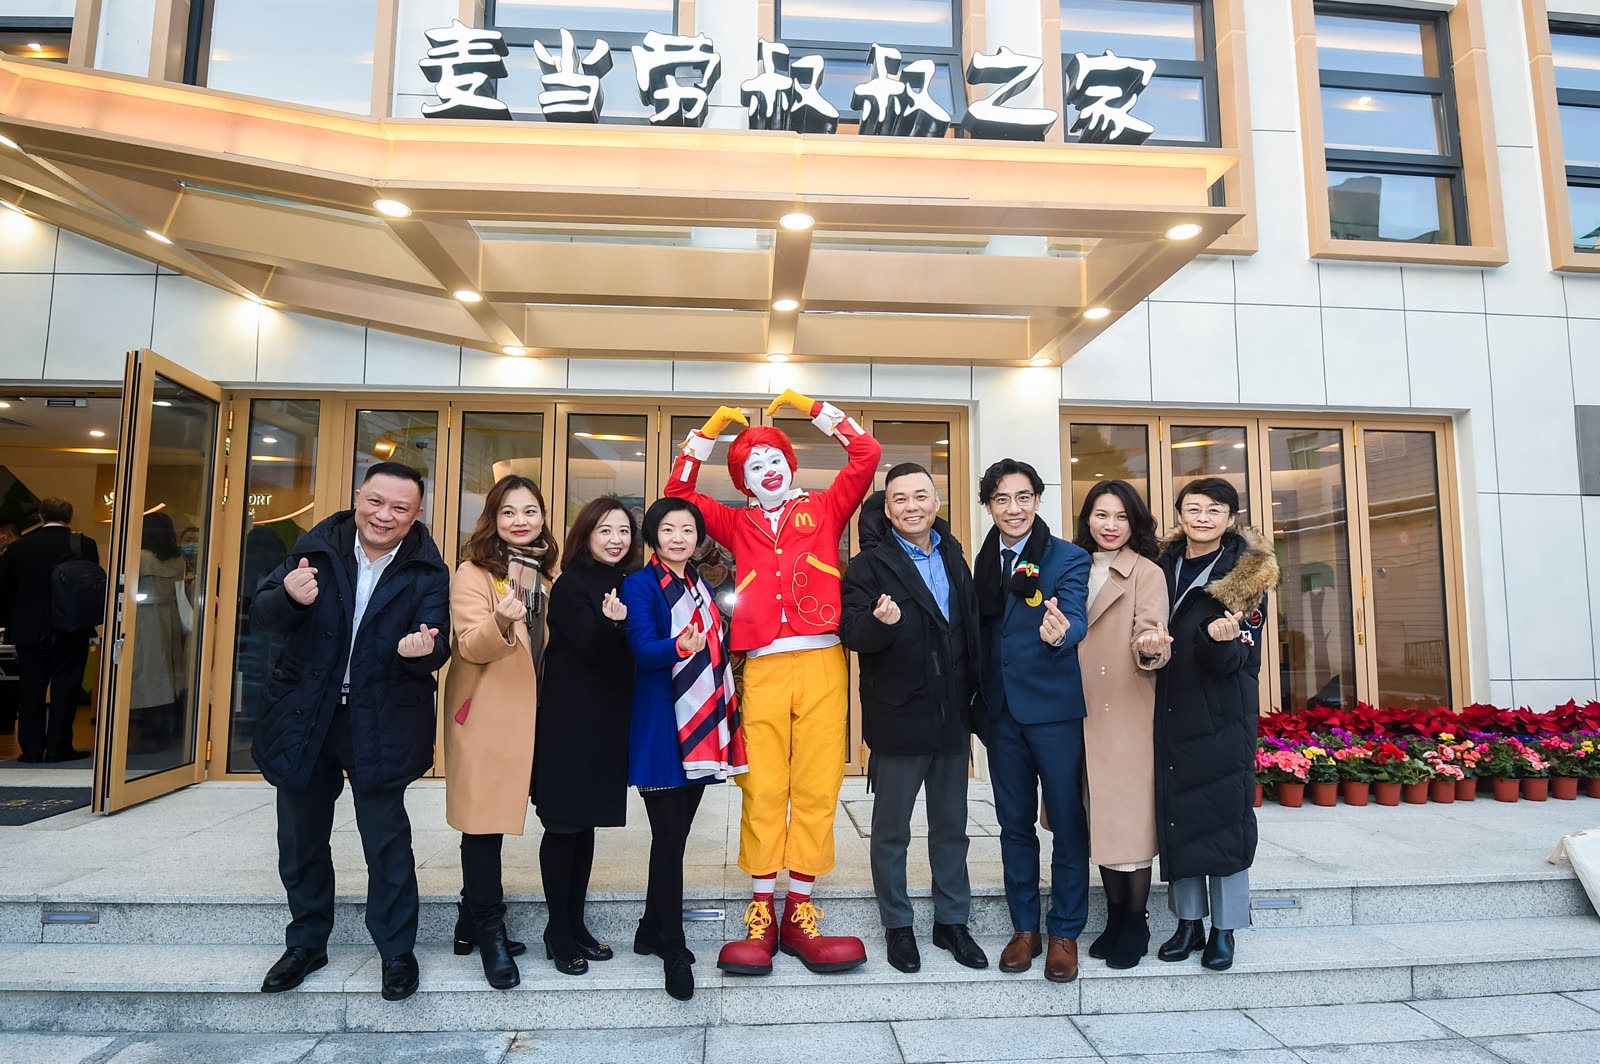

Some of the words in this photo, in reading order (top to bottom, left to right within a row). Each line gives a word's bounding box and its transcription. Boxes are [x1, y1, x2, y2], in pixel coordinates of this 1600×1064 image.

[417, 18, 1157, 143] 麦当劳叔叔之家
